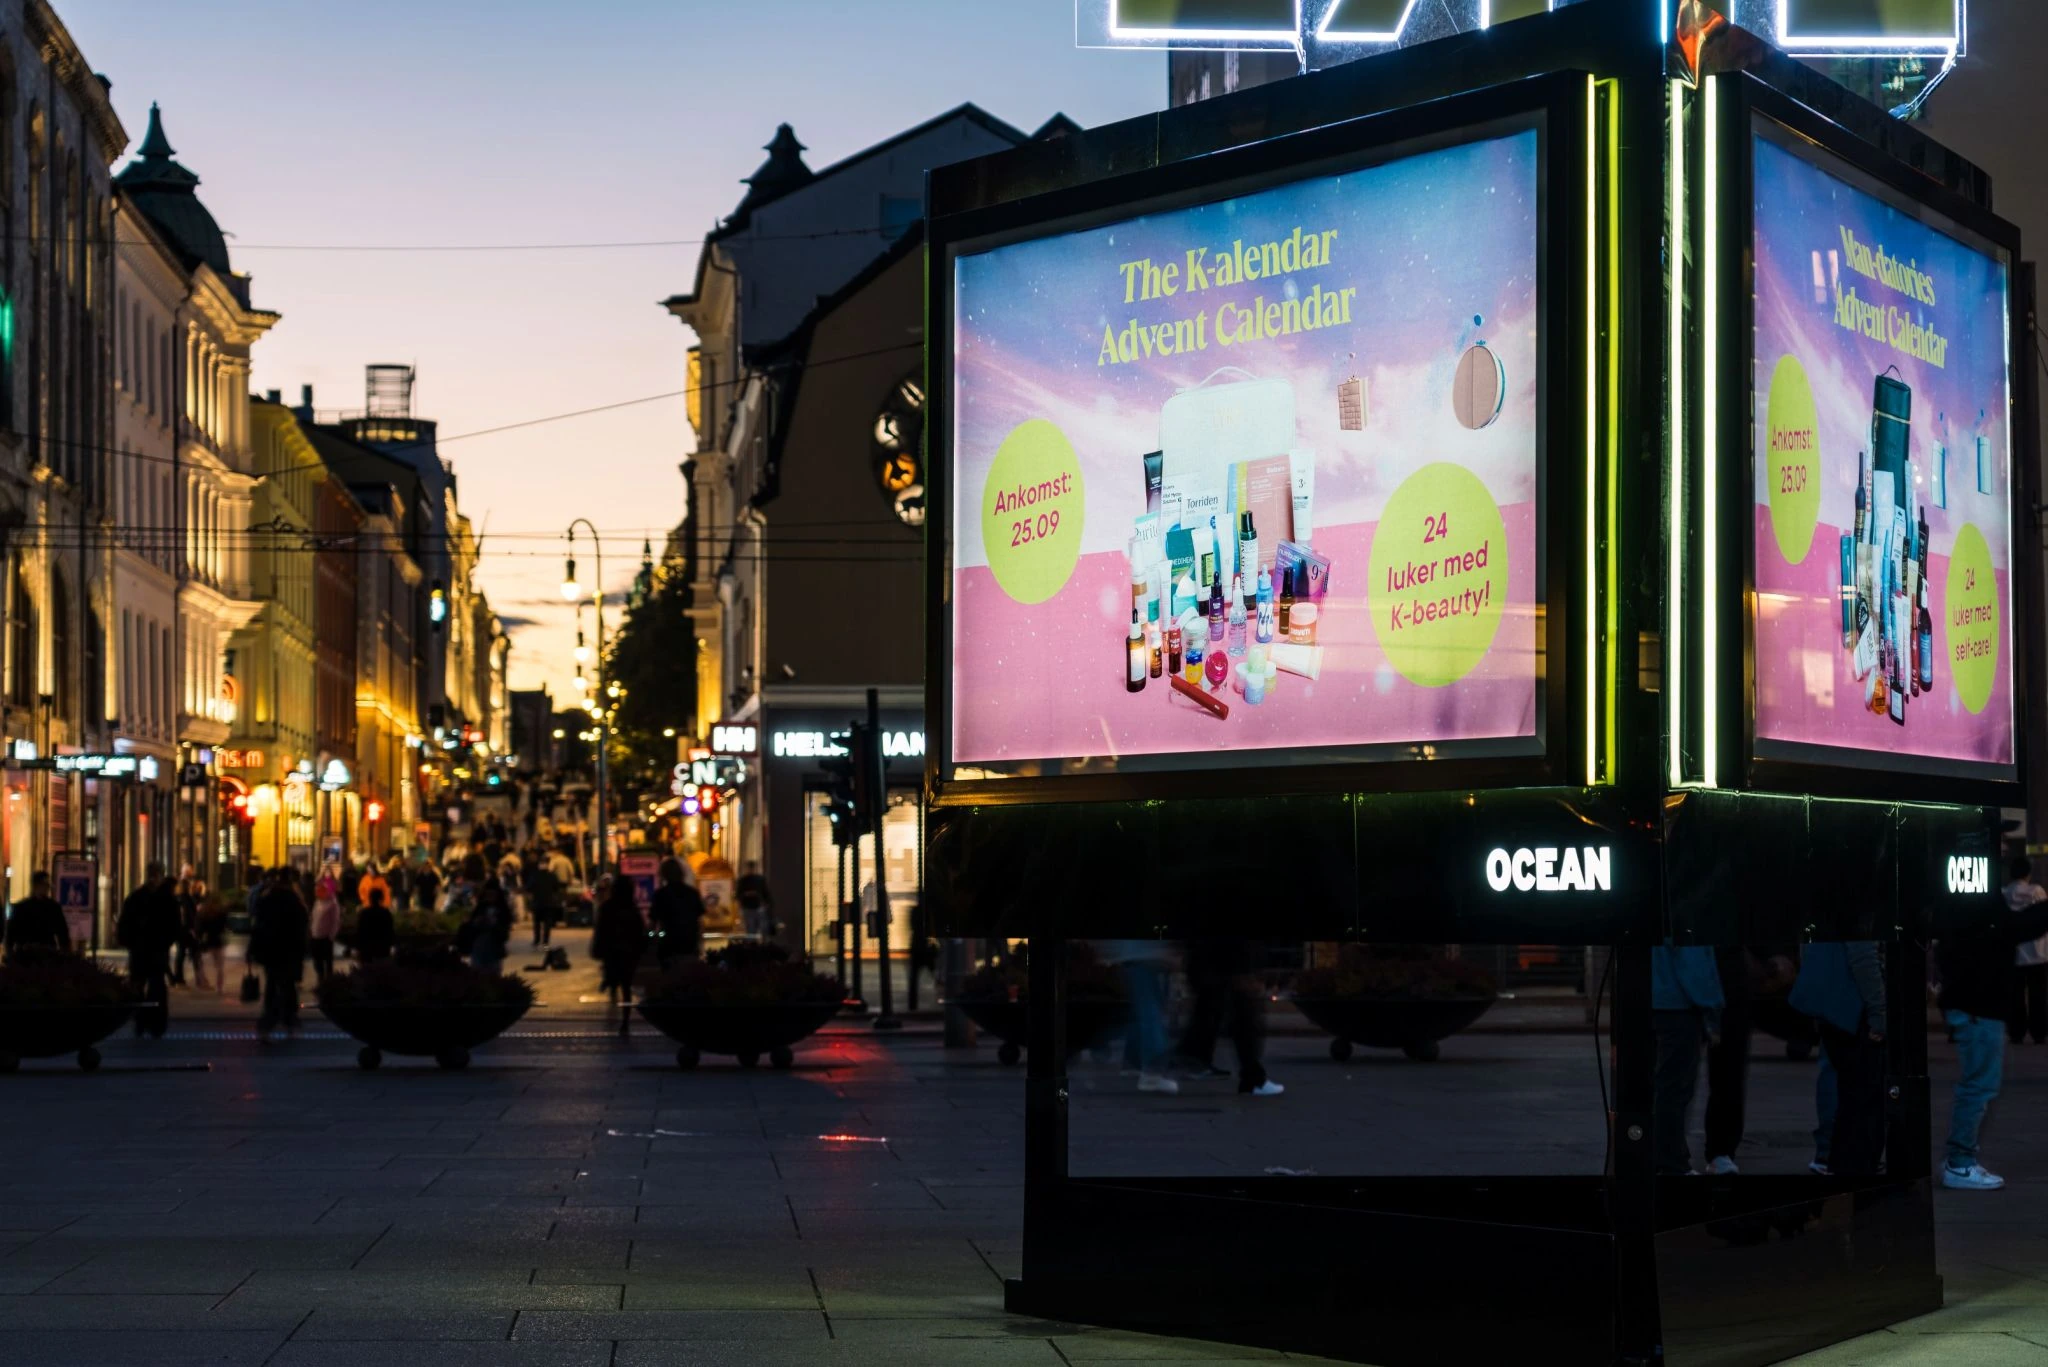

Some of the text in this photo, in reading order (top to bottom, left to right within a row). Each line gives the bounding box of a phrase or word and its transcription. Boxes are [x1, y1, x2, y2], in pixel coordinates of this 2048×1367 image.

[1120, 228, 1337, 304] The K-alendar
[1839, 224, 1936, 307] Man-datories
[1098, 286, 1357, 366] Advent Calendar
[1833, 281, 1948, 369] Advent Calendar
[1771, 426, 1813, 451] Ankomst:
[993, 471, 1073, 516] Ankomst:
[1781, 465, 1807, 494] 25.09
[1011, 508, 1061, 548] 25.09
[1423, 511, 1449, 545] 24
[1387, 539, 1489, 594] luker med
[1964, 568, 1976, 591] 24
[1390, 580, 1491, 633] K-beauty!
[1952, 603, 1992, 629] luker med
[1954, 635, 1992, 662] self-care!
[1486, 847, 1611, 892] OCEAN
[1947, 855, 1989, 894] OCEAN
